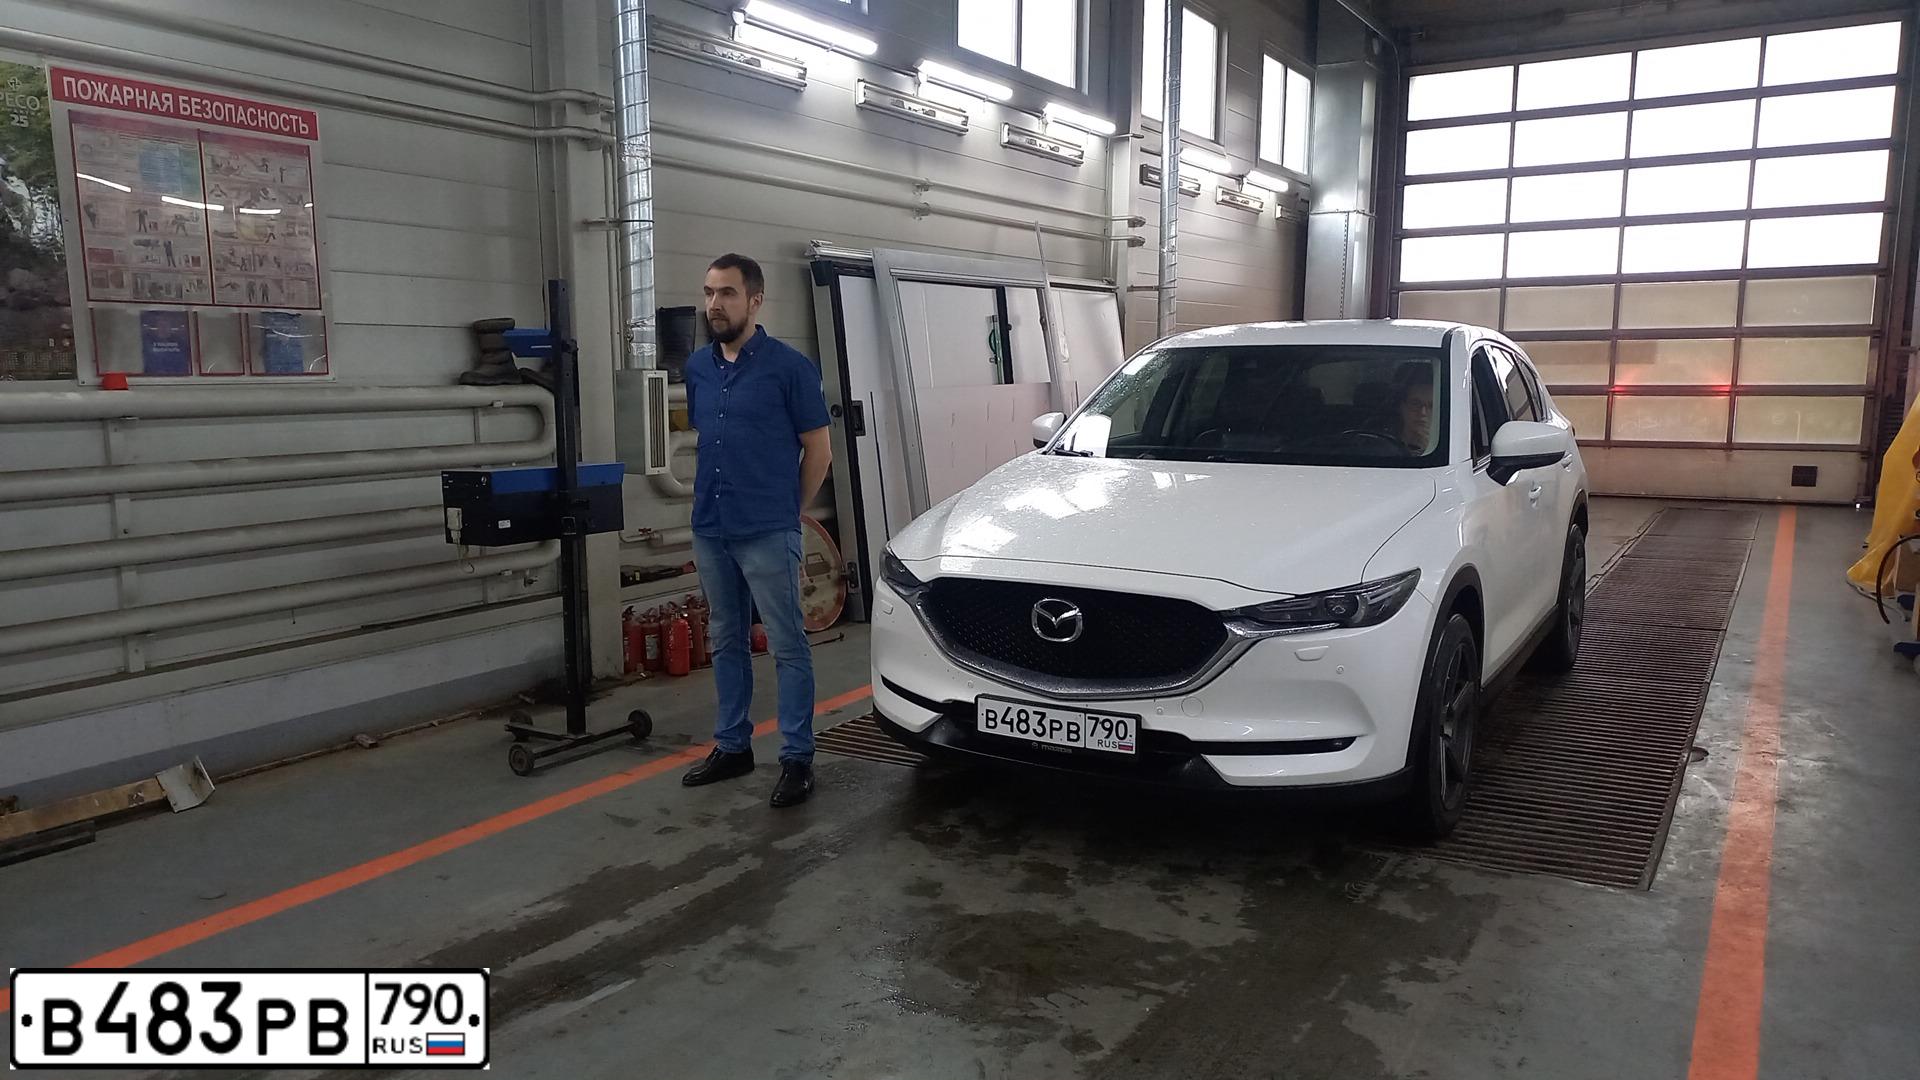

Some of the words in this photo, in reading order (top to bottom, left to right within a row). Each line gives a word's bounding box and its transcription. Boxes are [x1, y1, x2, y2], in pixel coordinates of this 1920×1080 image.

[63, 76, 174, 113] ПОЖАРНАЯ
[178, 96, 310, 135] БЕЗОПАСНОСТЬ
[10, 113, 29, 127] 25
[985, 706, 1081, 743] В483РВ
[1087, 716, 1129, 740] 790
[1097, 739, 1118, 749] RUS
